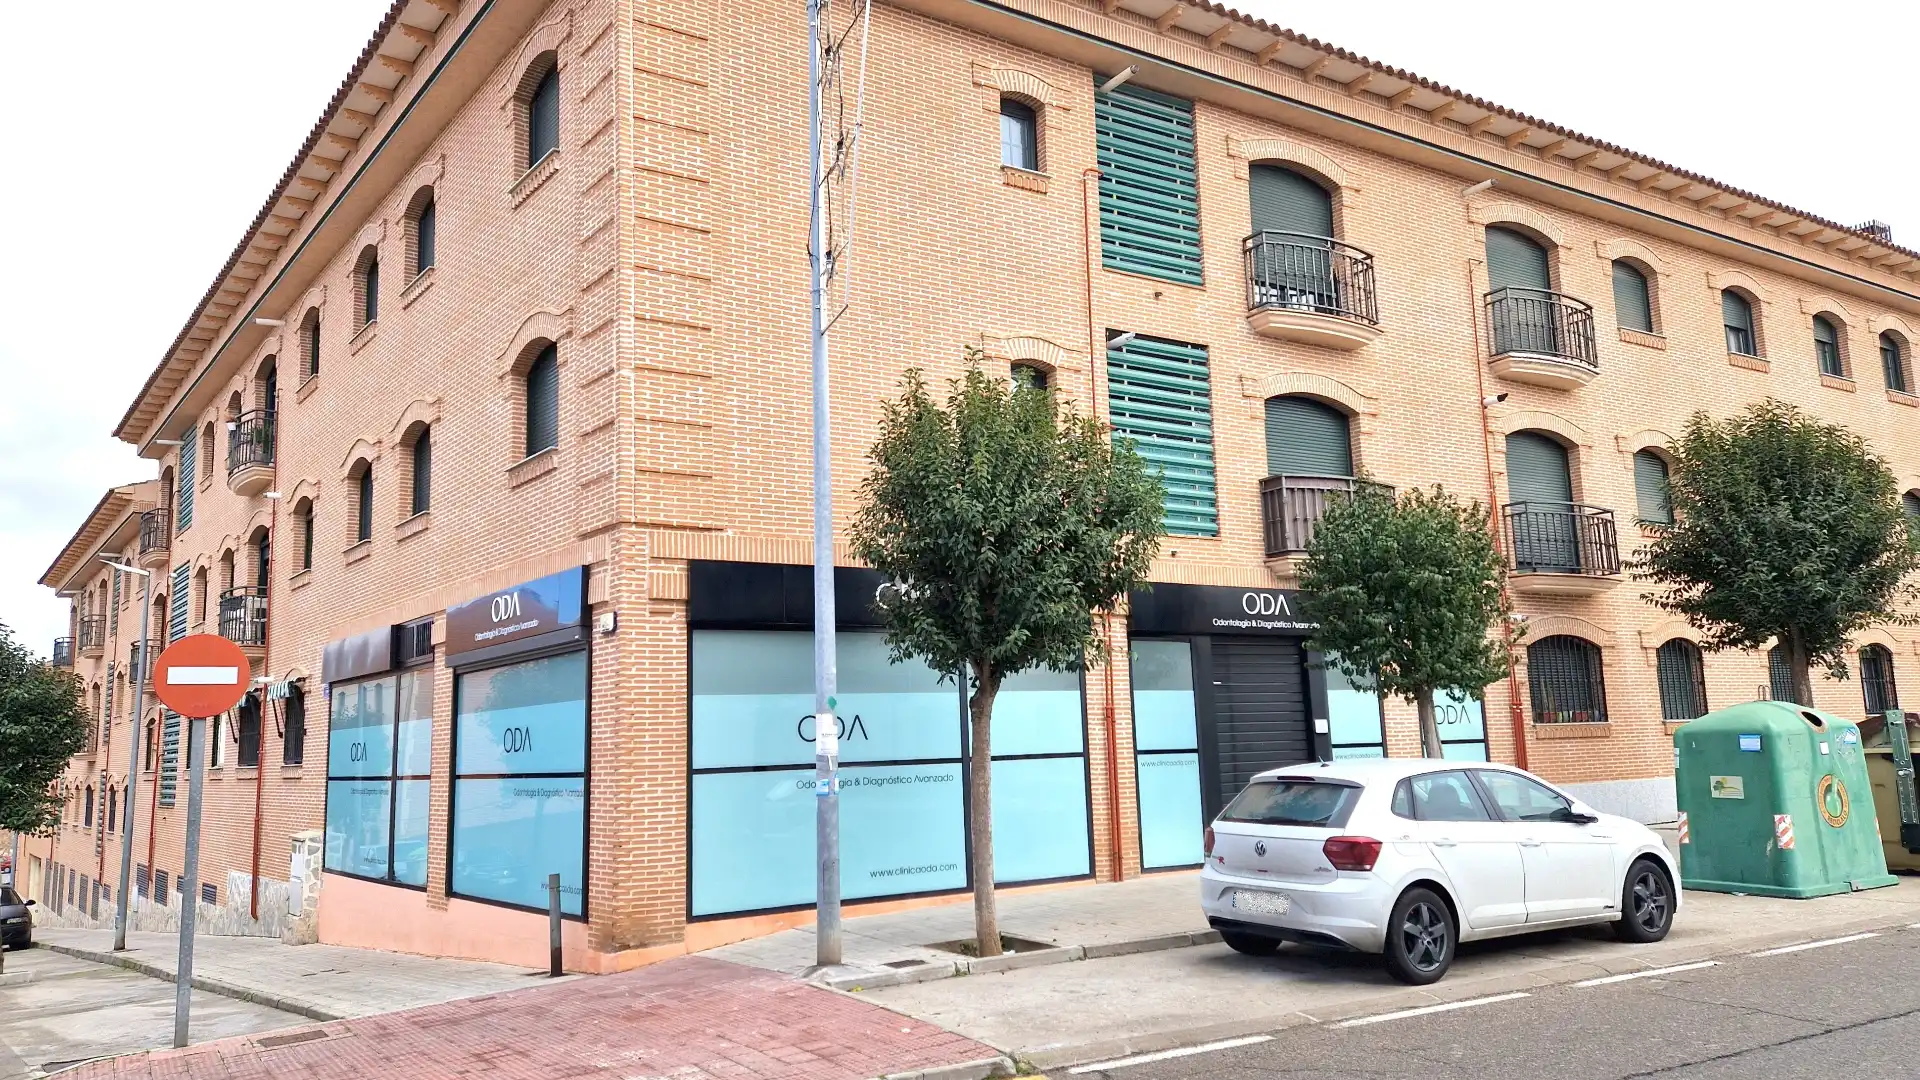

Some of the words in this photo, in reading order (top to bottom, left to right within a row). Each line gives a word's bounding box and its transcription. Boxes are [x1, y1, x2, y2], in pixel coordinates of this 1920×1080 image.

[491, 592, 520, 622] ODA
[1242, 592, 1291, 616] ODA
[1434, 705, 1471, 725] ODA
[503, 726, 532, 753] ODA
[350, 742, 367, 762] ODA
[854, 777, 861, 786] &
[862, 775, 912, 788] Diagnóstico
[914, 774, 954, 783] Avanzado
[869, 863, 958, 879] www.clinicaoda.com
